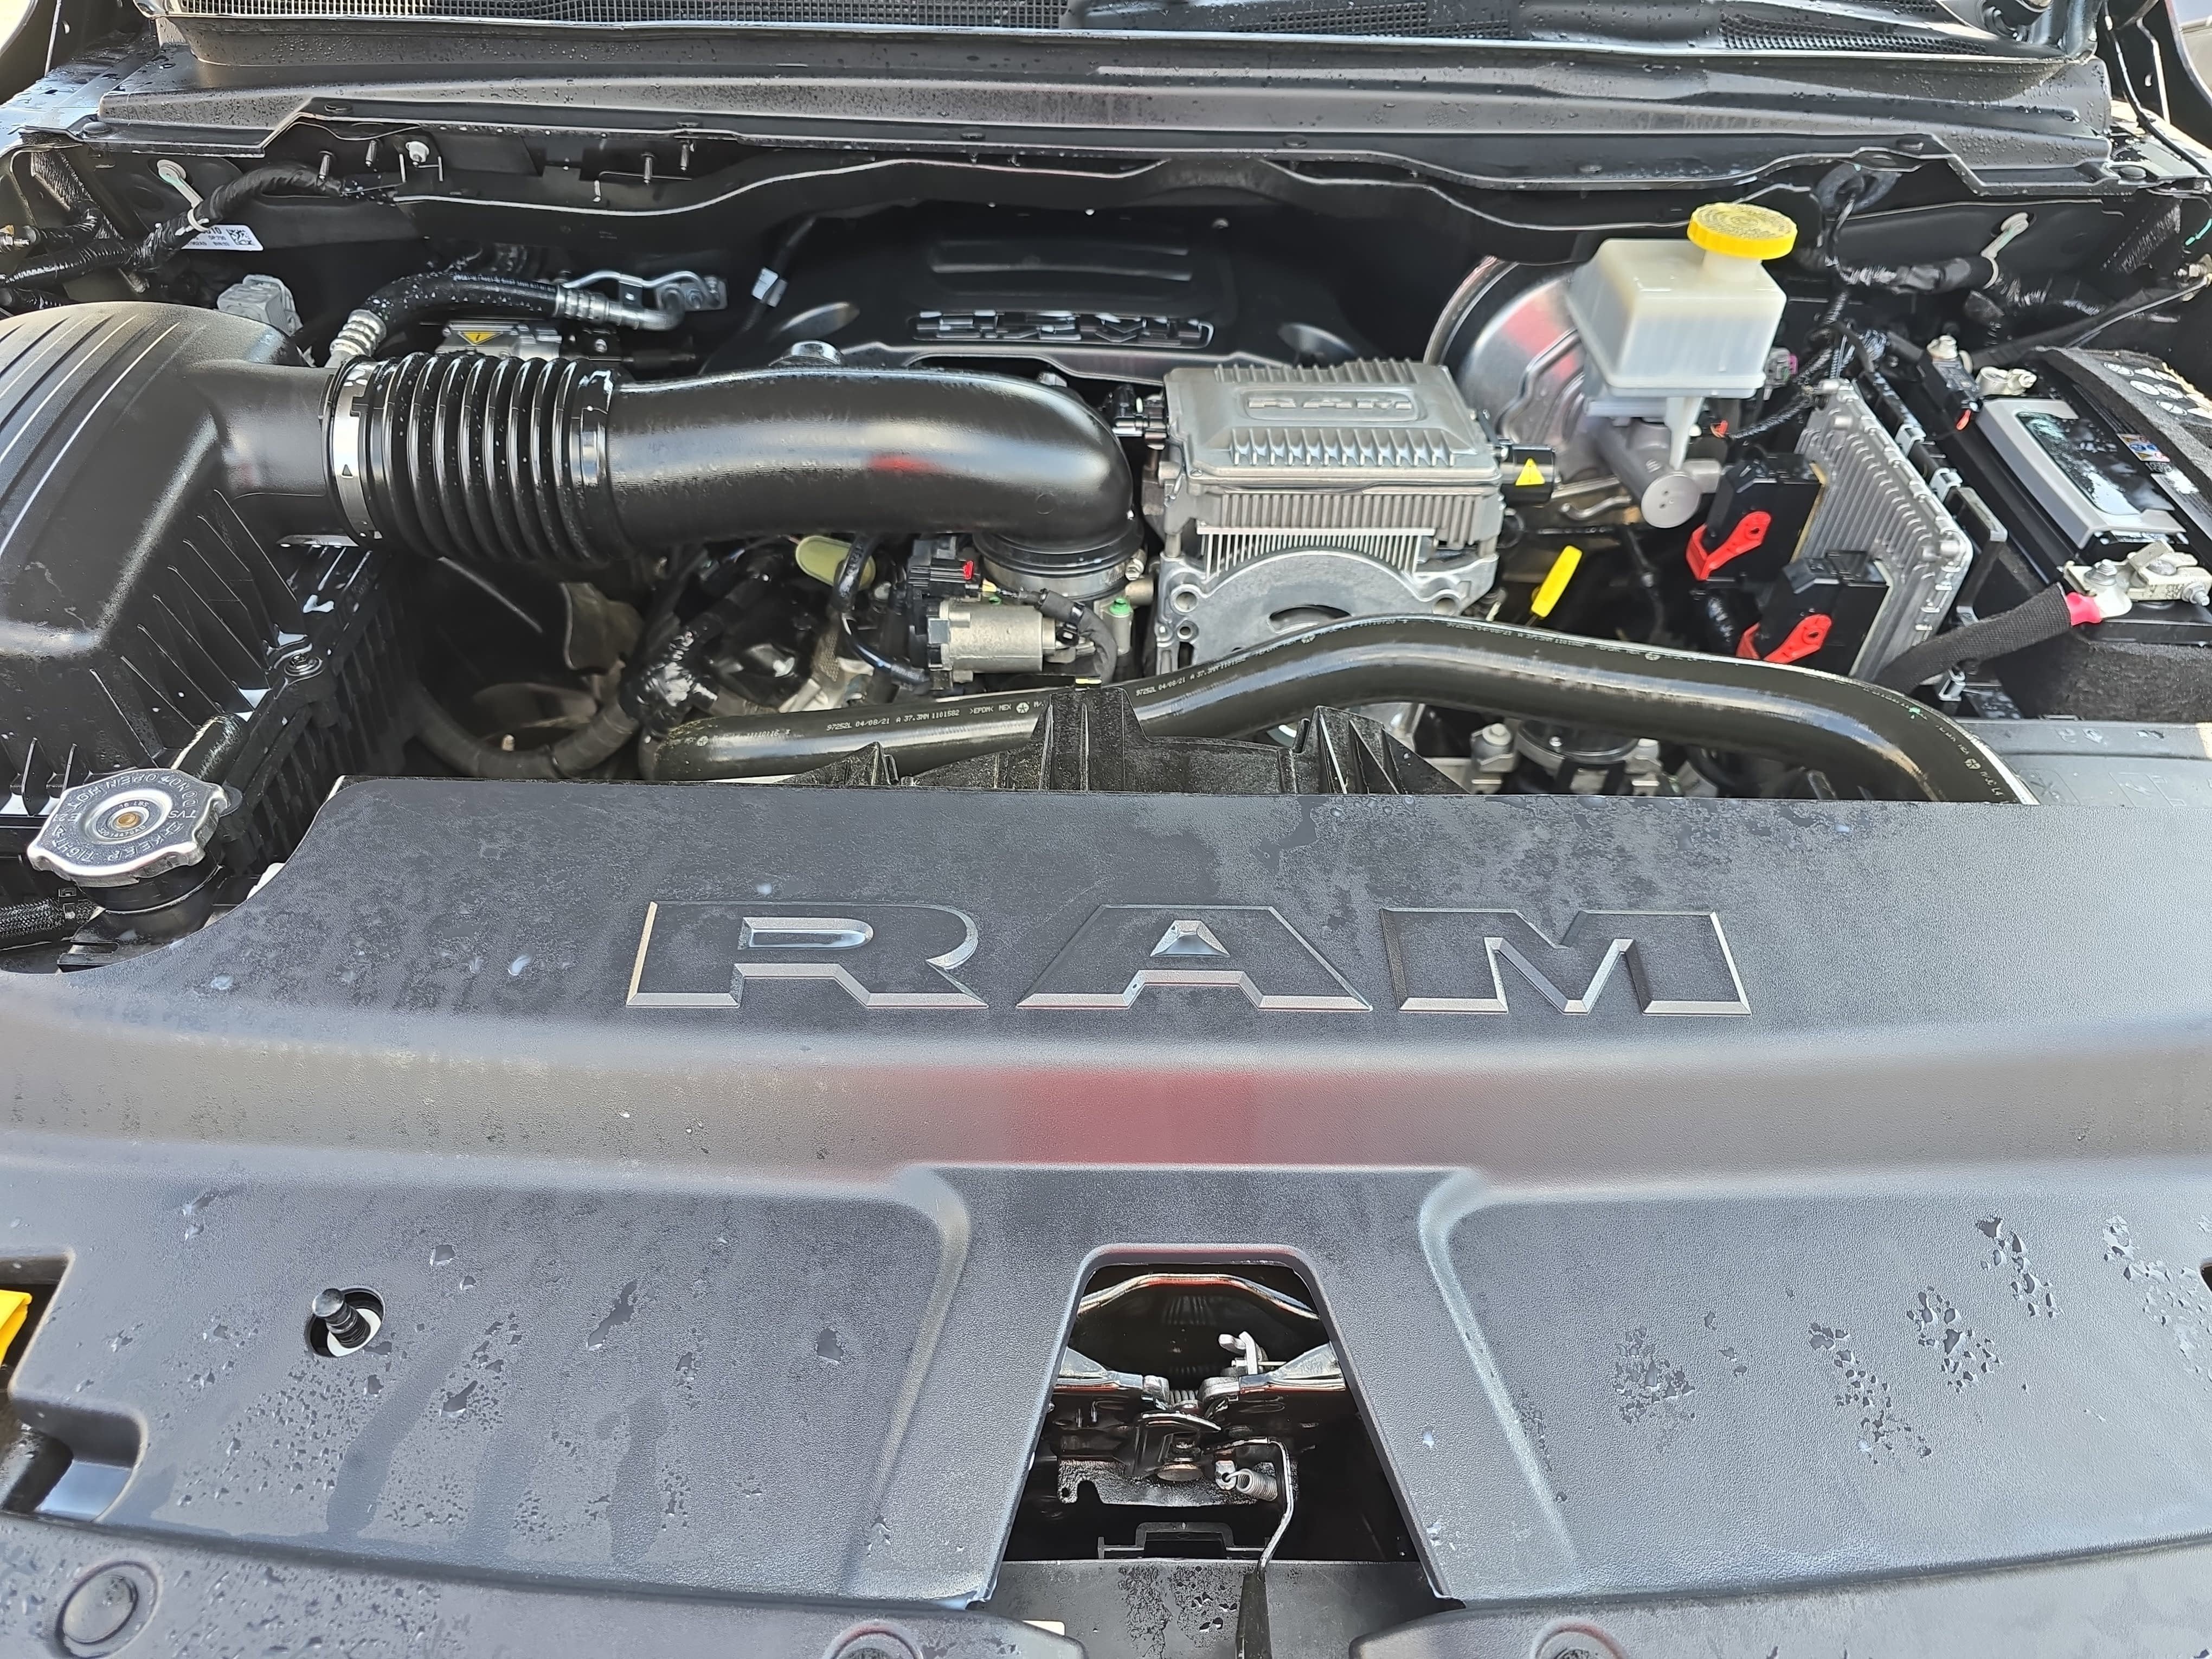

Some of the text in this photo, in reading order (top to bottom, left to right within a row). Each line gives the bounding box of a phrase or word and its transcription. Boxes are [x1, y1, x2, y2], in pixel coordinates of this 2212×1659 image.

[1248, 397, 1412, 410] RAM
[855, 718, 890, 728] 04/08/21
[106, 773, 159, 788] OPEN
[67, 785, 102, 812] HOT
[167, 809, 196, 819] TVS
[52, 832, 164, 863] KEEP TIGHT
[626, 901, 1753, 1016] RAM
